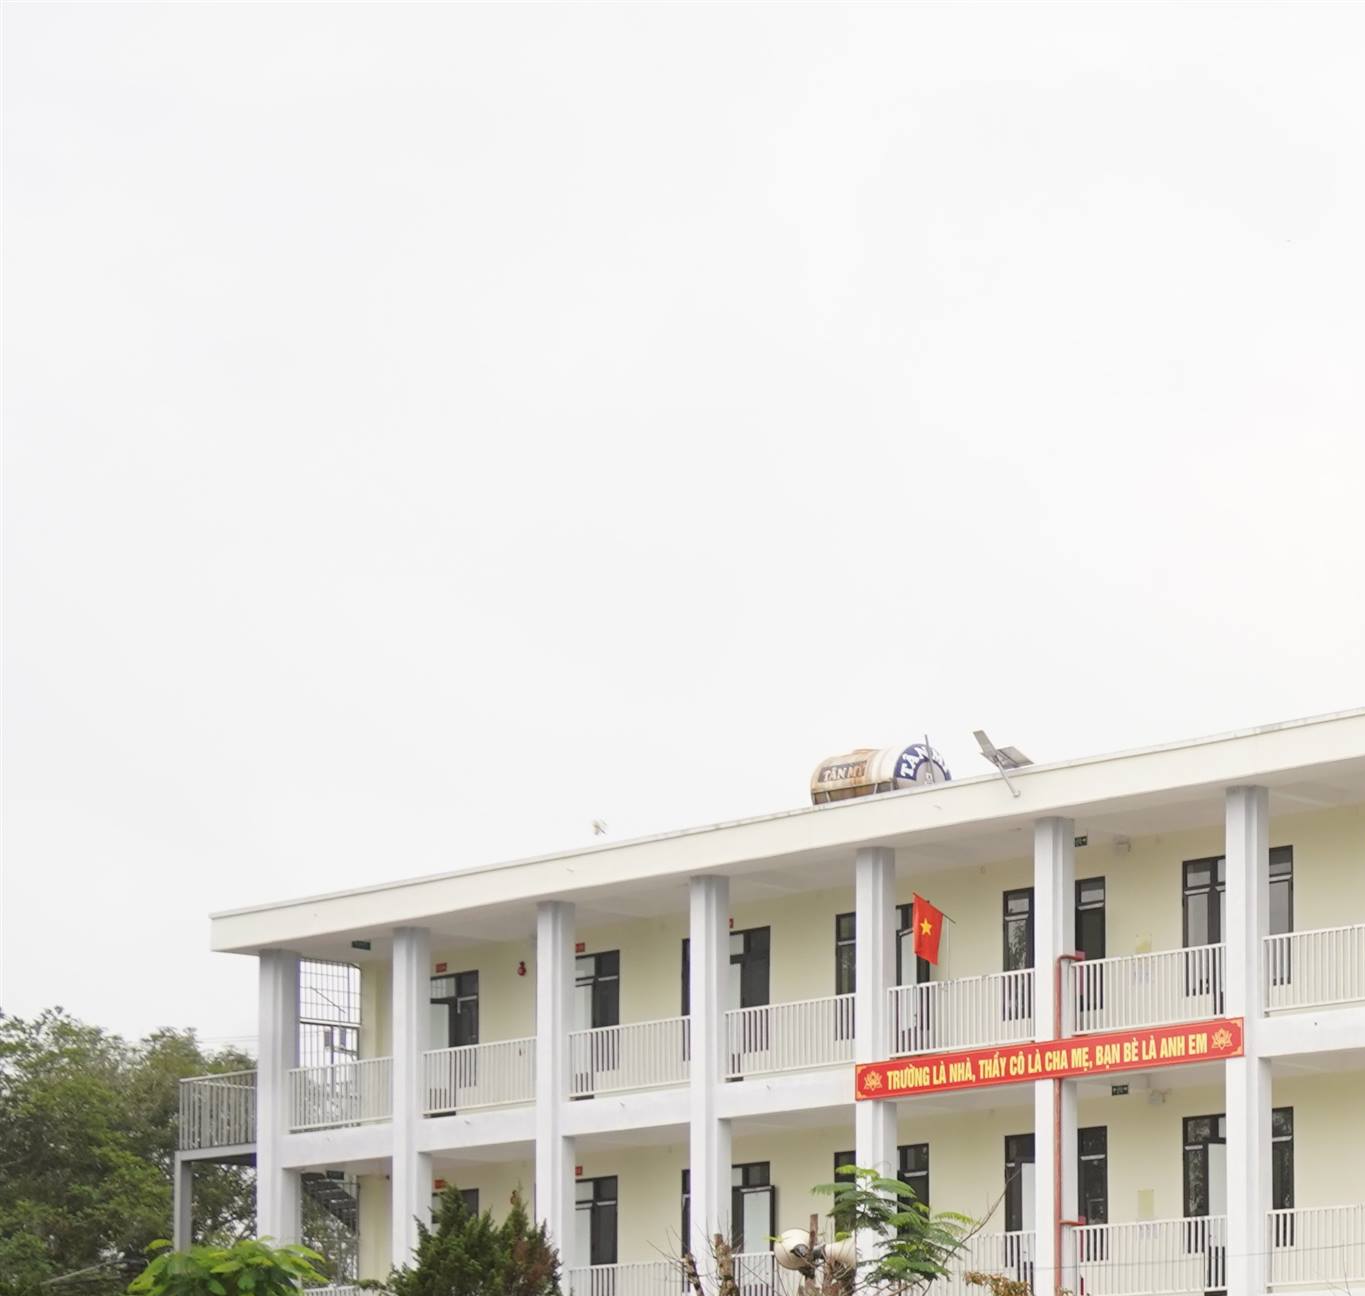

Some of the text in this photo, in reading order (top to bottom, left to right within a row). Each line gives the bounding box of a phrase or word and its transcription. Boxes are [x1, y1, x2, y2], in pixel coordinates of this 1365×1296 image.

[887, 1063, 930, 1090] TRƯỜNG
[932, 1061, 946, 1086] LÀ
[950, 1057, 975, 1082] NHÀ,
[1010, 1051, 1025, 1074] CÔ
[1028, 1049, 1042, 1072] LÀ
[1045, 1049, 1068, 1071] CHA
[1071, 1047, 1093, 1072] MẸ,
[1096, 1043, 1120, 1070] BẠN
[1124, 1037, 1138, 1062] BÈ
[1142, 1035, 1157, 1060] LÀ
[1160, 1035, 1185, 1058] ANH
[1188, 1033, 1207, 1054] EM
